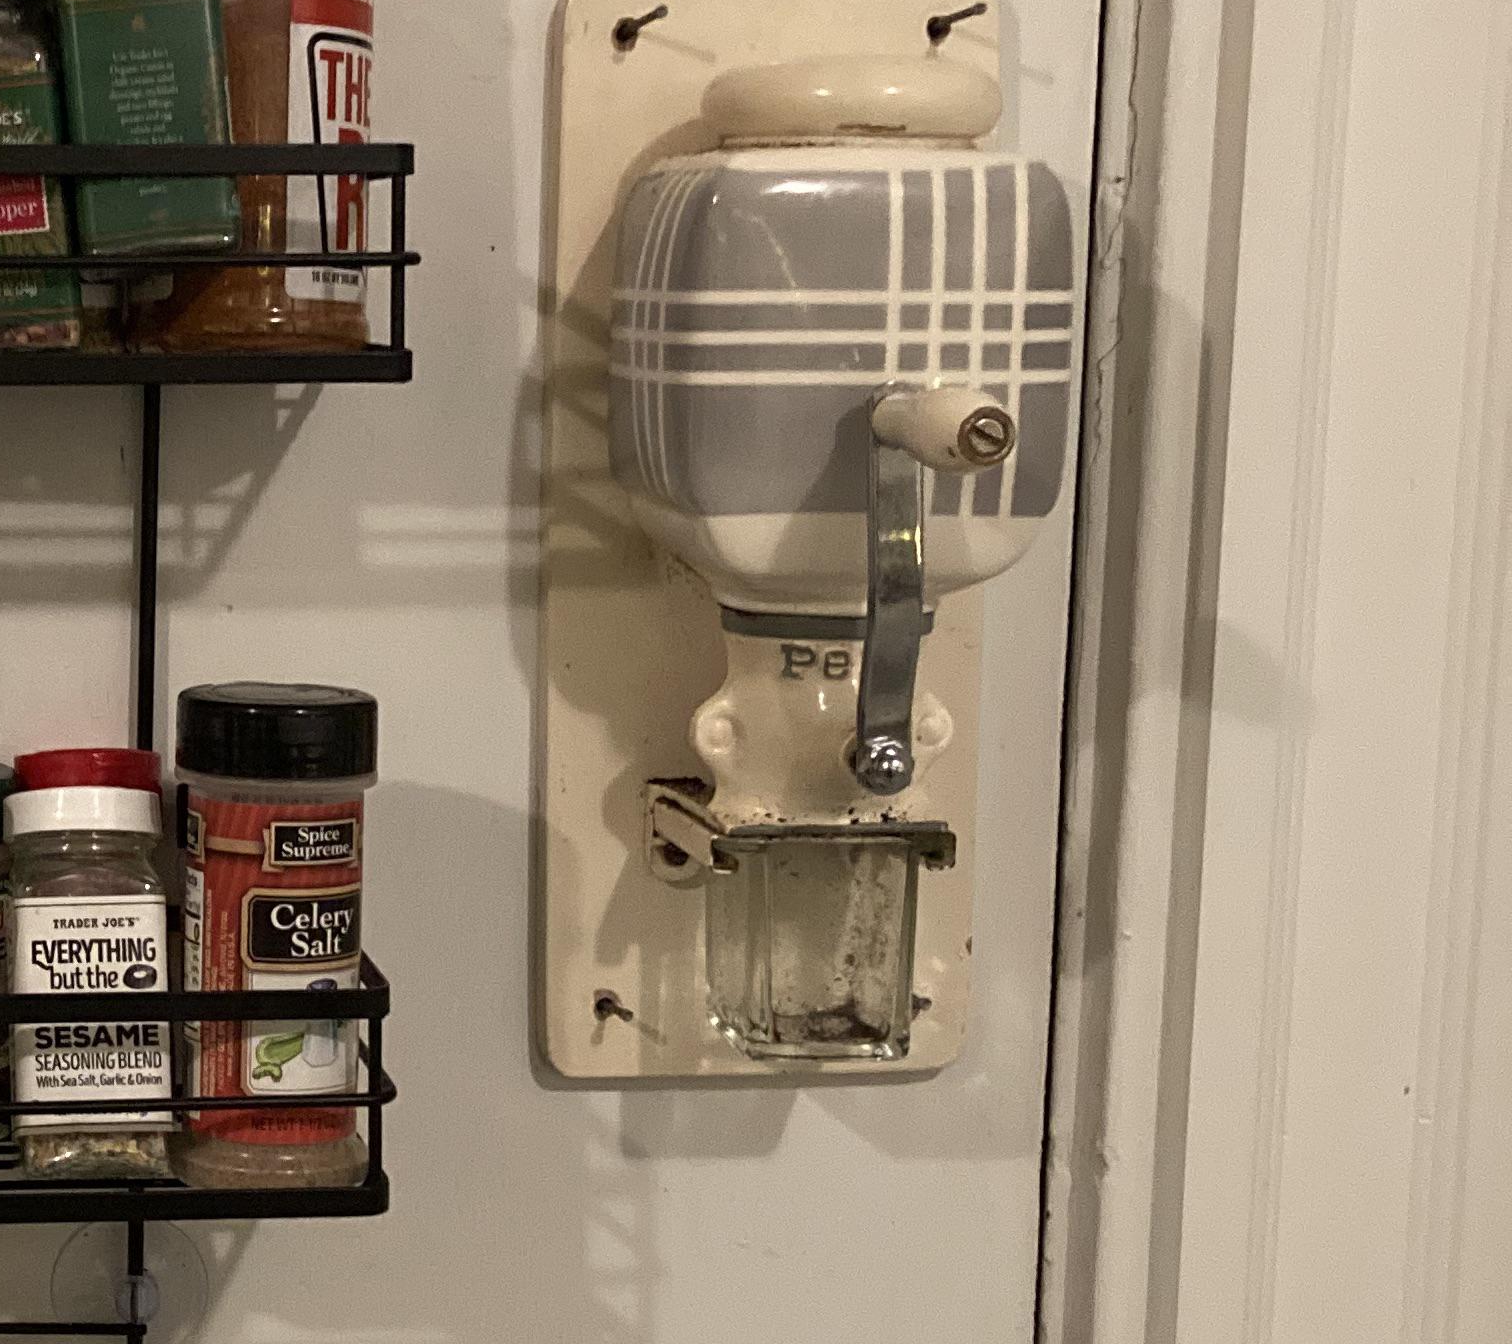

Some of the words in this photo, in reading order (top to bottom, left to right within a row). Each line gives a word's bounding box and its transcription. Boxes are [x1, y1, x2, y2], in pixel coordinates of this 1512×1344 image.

[297, 826, 340, 845] Spice
[281, 841, 351, 861] Supreme
[53, 918, 98, 929] TRADER
[102, 917, 136, 927] JOE'S
[270, 902, 355, 934] Celery
[31, 937, 156, 964] EVERYTHING
[290, 928, 341, 958] Salt
[49, 965, 84, 990] but
[86, 964, 118, 988] the
[34, 1025, 159, 1050] SESAME
[34, 1052, 115, 1072] SEASONING
[117, 1050, 162, 1069] BLEND
[36, 1074, 58, 1088] With
[60, 1073, 77, 1087] Sea
[78, 1073, 99, 1088] Salt,
[100, 1072, 126, 1087] Garlic
[127, 1072, 135, 1085] &
[136, 1071, 162, 1085] Onion
